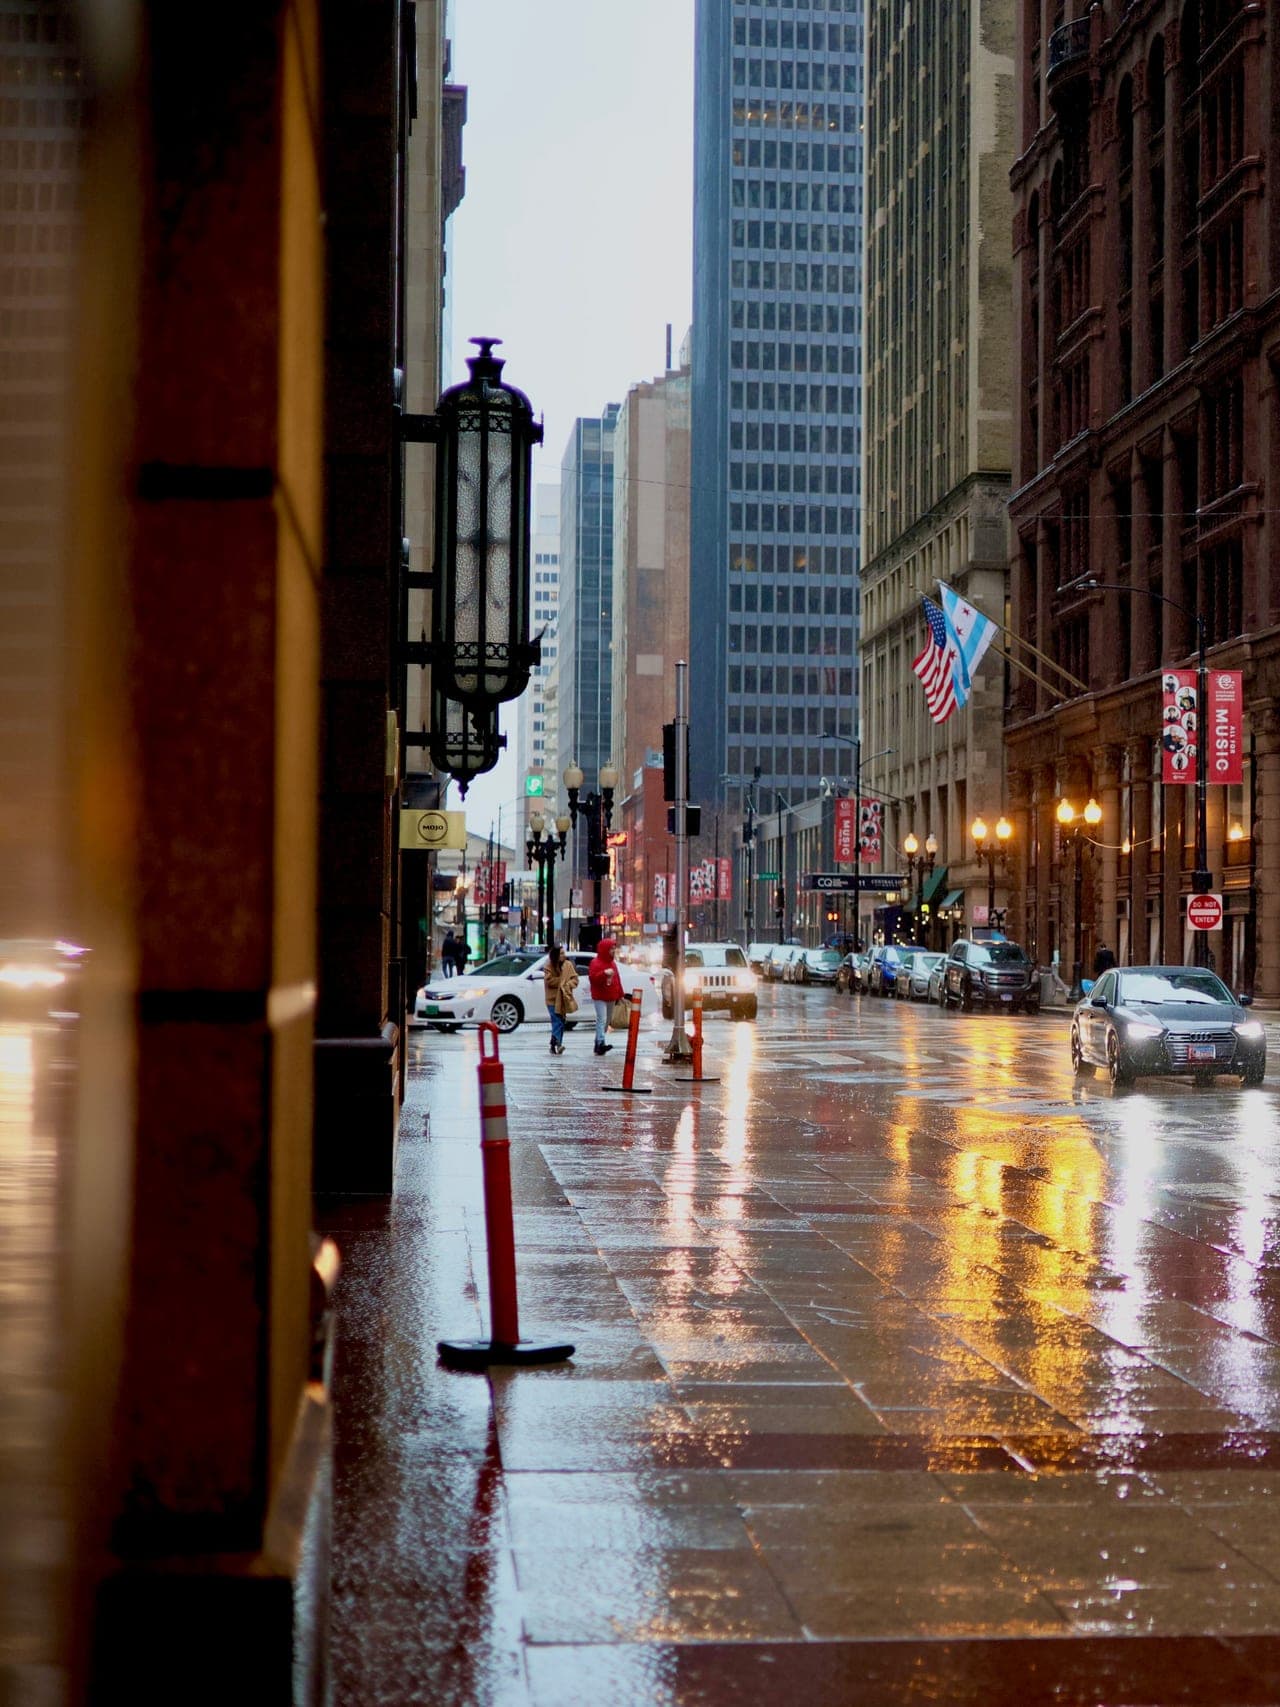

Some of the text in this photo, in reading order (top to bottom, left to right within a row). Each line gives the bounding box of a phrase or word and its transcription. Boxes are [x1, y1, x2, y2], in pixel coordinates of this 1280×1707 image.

[1215, 708, 1229, 771] MUSIC
[841, 820, 850, 856] MUSIC
[817, 878, 832, 887] CQ
